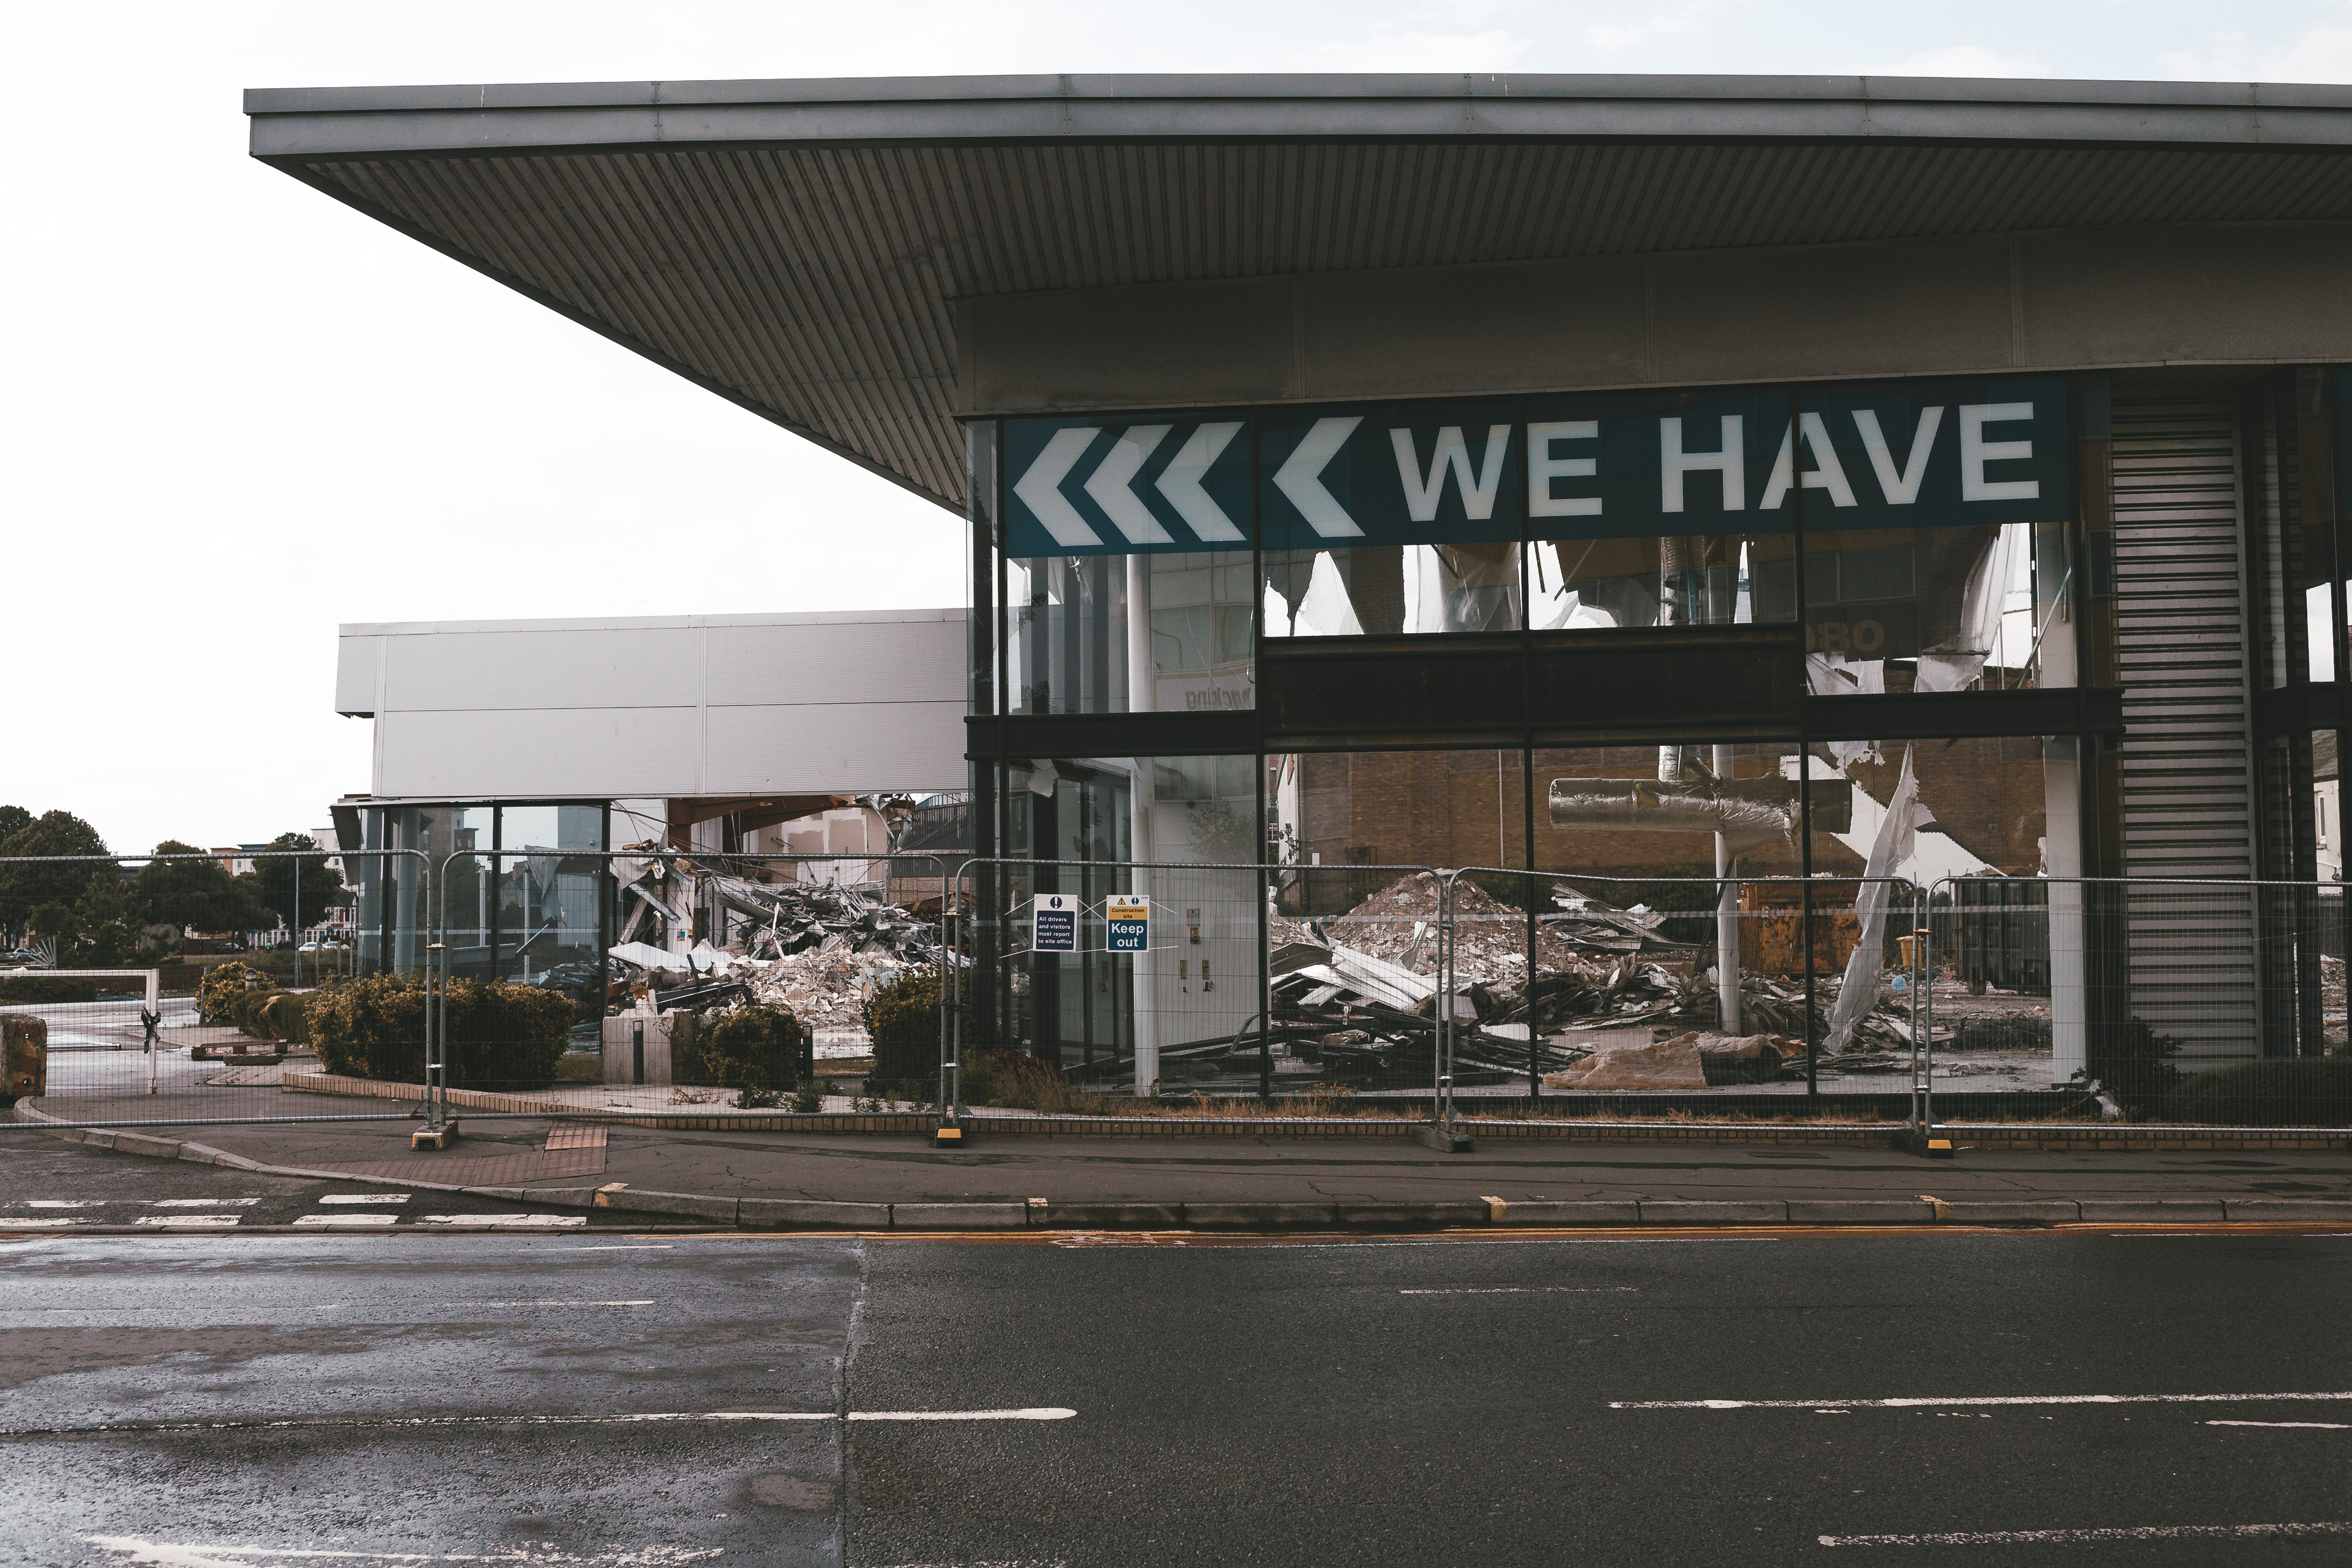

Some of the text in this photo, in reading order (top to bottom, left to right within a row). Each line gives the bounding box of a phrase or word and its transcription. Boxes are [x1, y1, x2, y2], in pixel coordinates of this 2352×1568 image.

[1389, 402, 2039, 521] WE HAVE
[1111, 923, 1144, 936] Keep
[1117, 937, 1138, 947] out
